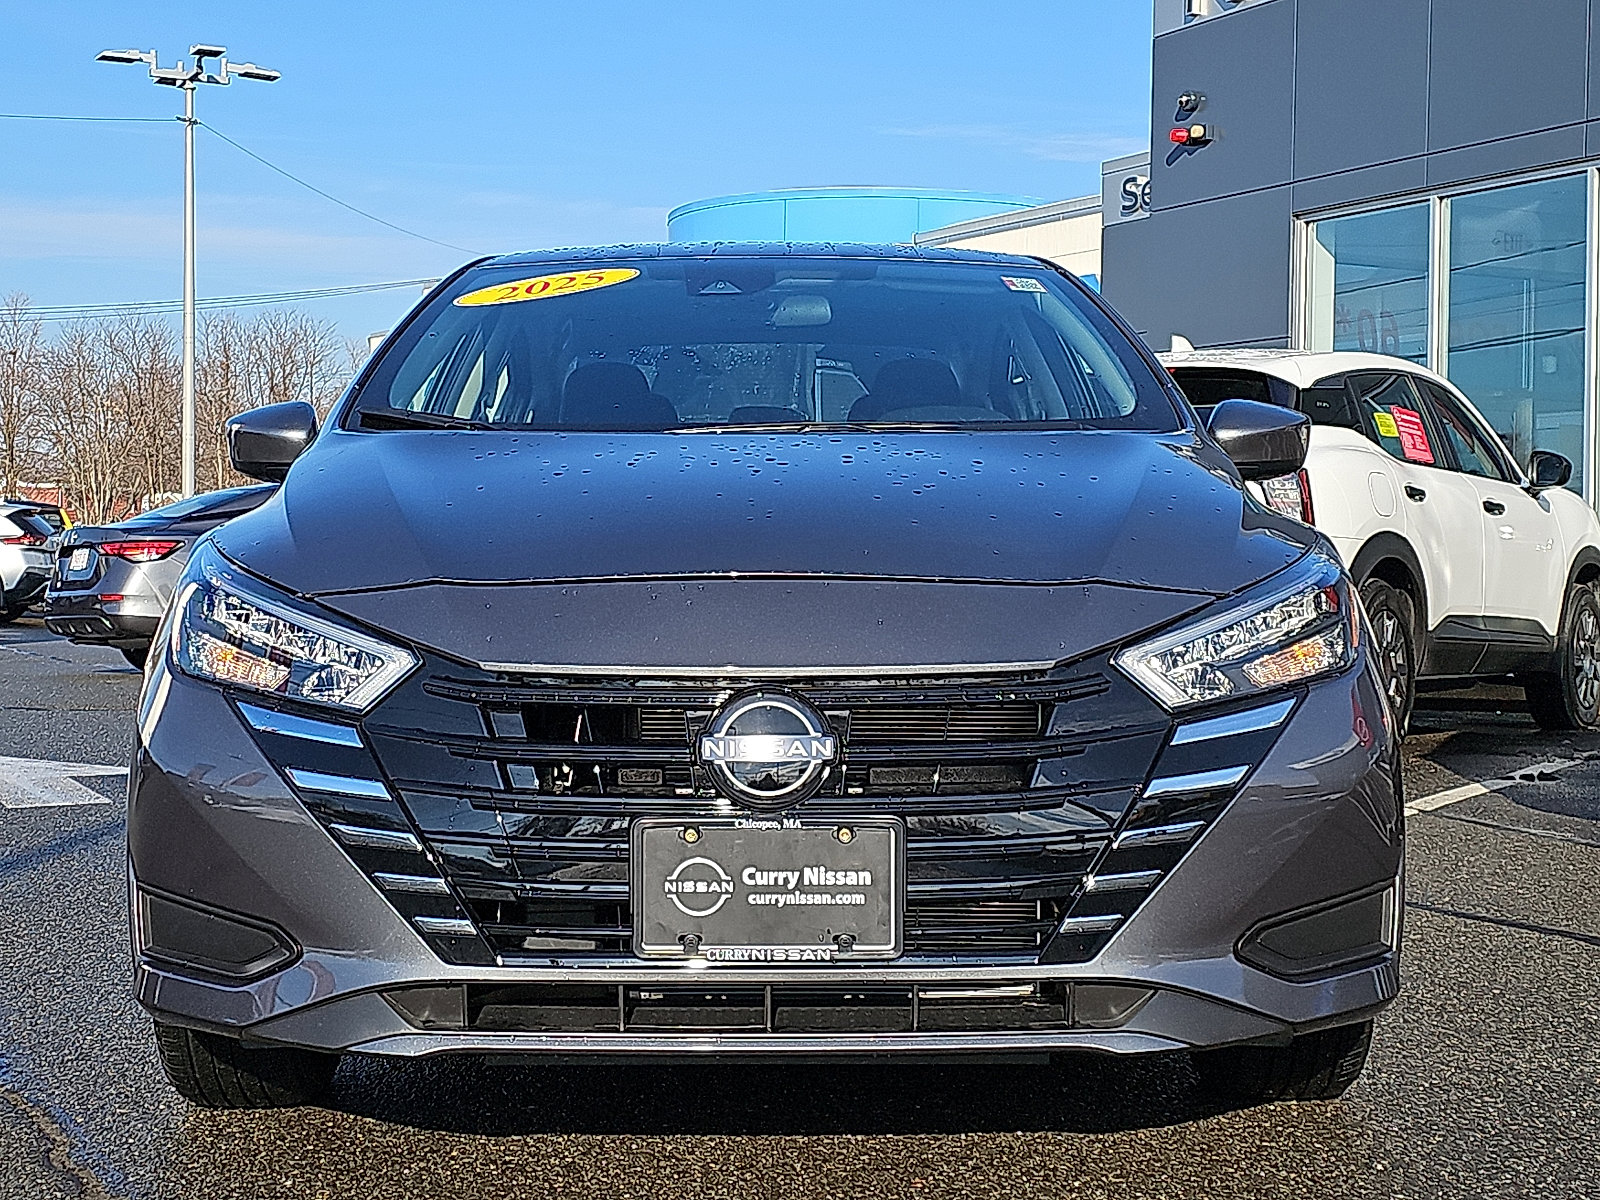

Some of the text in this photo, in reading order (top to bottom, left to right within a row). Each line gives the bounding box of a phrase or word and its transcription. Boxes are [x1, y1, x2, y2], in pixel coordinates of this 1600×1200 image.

[496, 271, 606, 301] 2025
[783, 818, 802, 829] MA
[742, 866, 872, 889] Curry Nissan
[664, 881, 734, 893] NISSAN
[747, 890, 866, 908] currynissan.com
